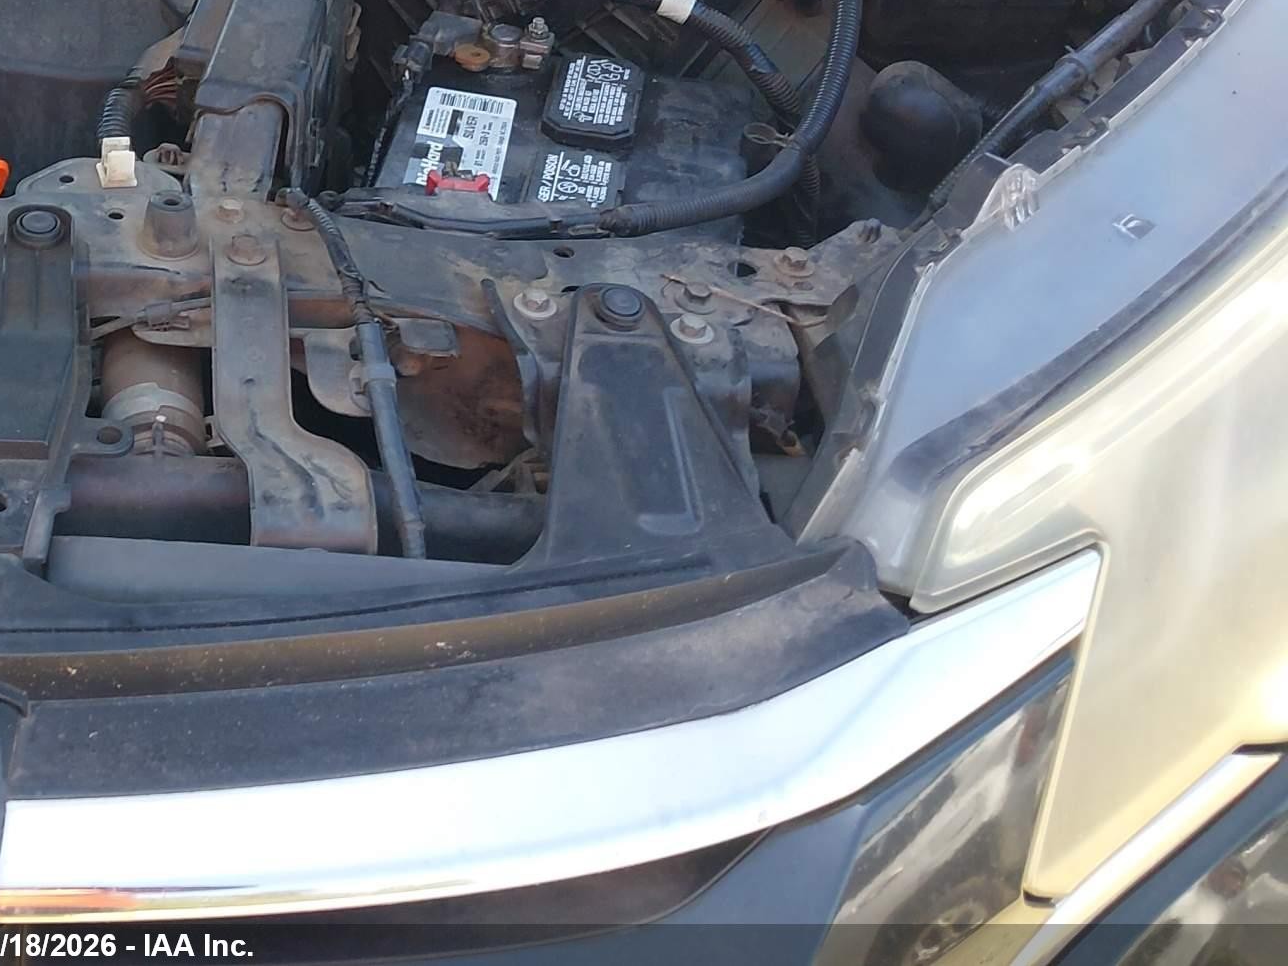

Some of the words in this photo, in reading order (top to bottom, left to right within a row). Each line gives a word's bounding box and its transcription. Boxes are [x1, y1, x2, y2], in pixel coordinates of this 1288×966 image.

[462, 115, 479, 140] SILVER
[415, 141, 444, 186] DieHard
[543, 154, 559, 180] POISON
